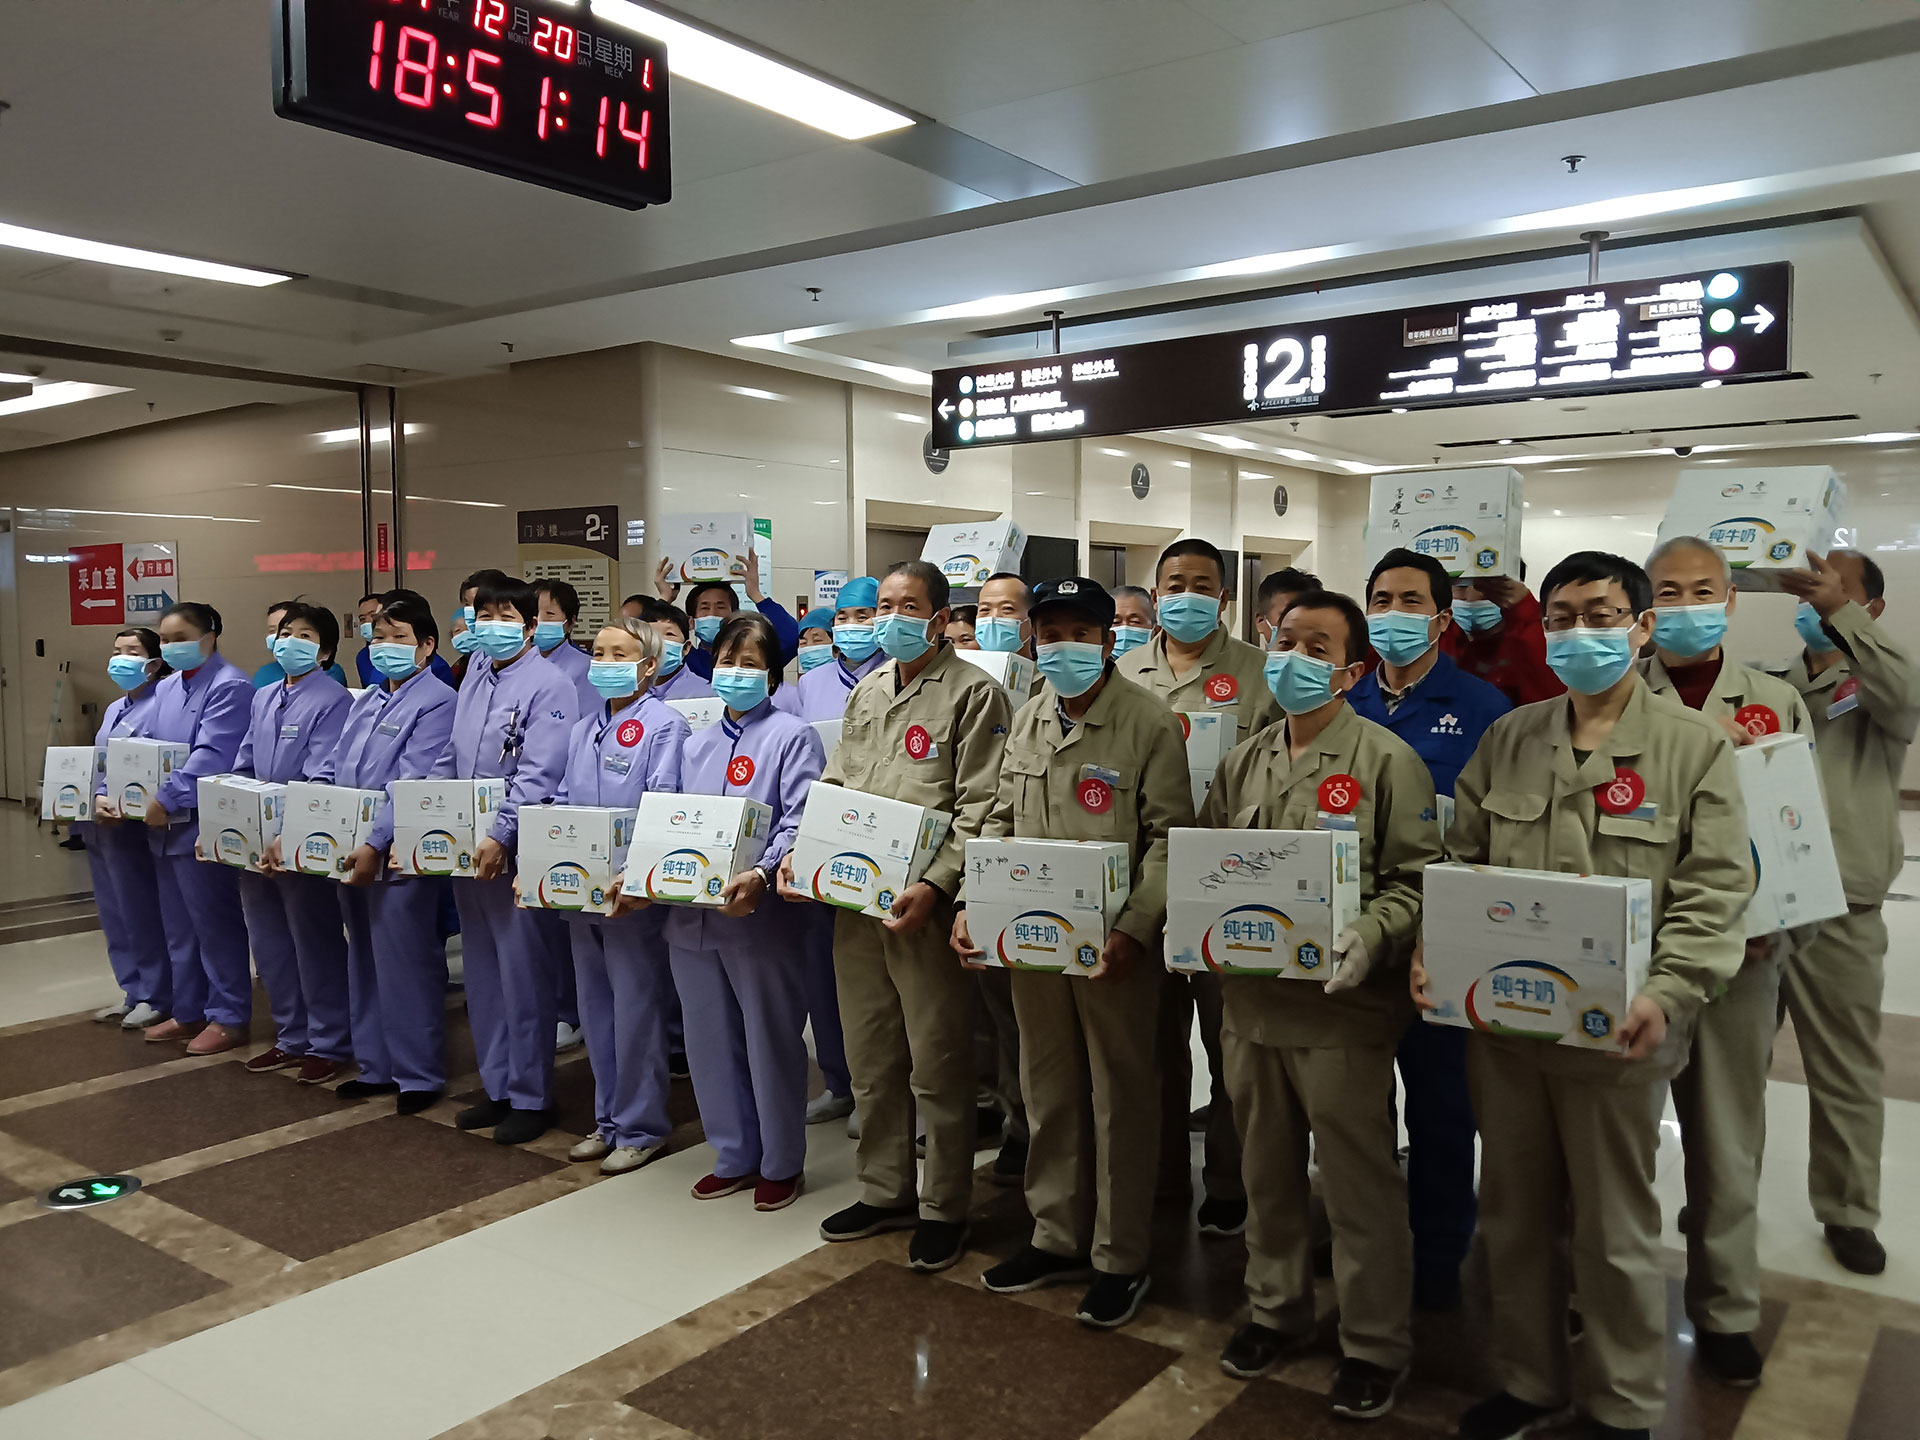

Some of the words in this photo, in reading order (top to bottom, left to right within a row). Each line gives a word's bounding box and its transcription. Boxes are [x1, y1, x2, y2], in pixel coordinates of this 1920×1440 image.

[523, 524, 558, 538] 门诊楼
[585, 513, 609, 541] 2F
[1415, 536, 1460, 553] 纯牛奶
[78, 566, 117, 591] 采血室
[662, 859, 697, 877] 纯牛奶
[830, 860, 868, 885] 纯牛奶
[550, 872, 580, 888] 纯牛奶
[1014, 922, 1059, 943] 纯牛奶
[1223, 919, 1275, 942] 纯牛奶
[1492, 974, 1556, 1004] 纯牛奶
